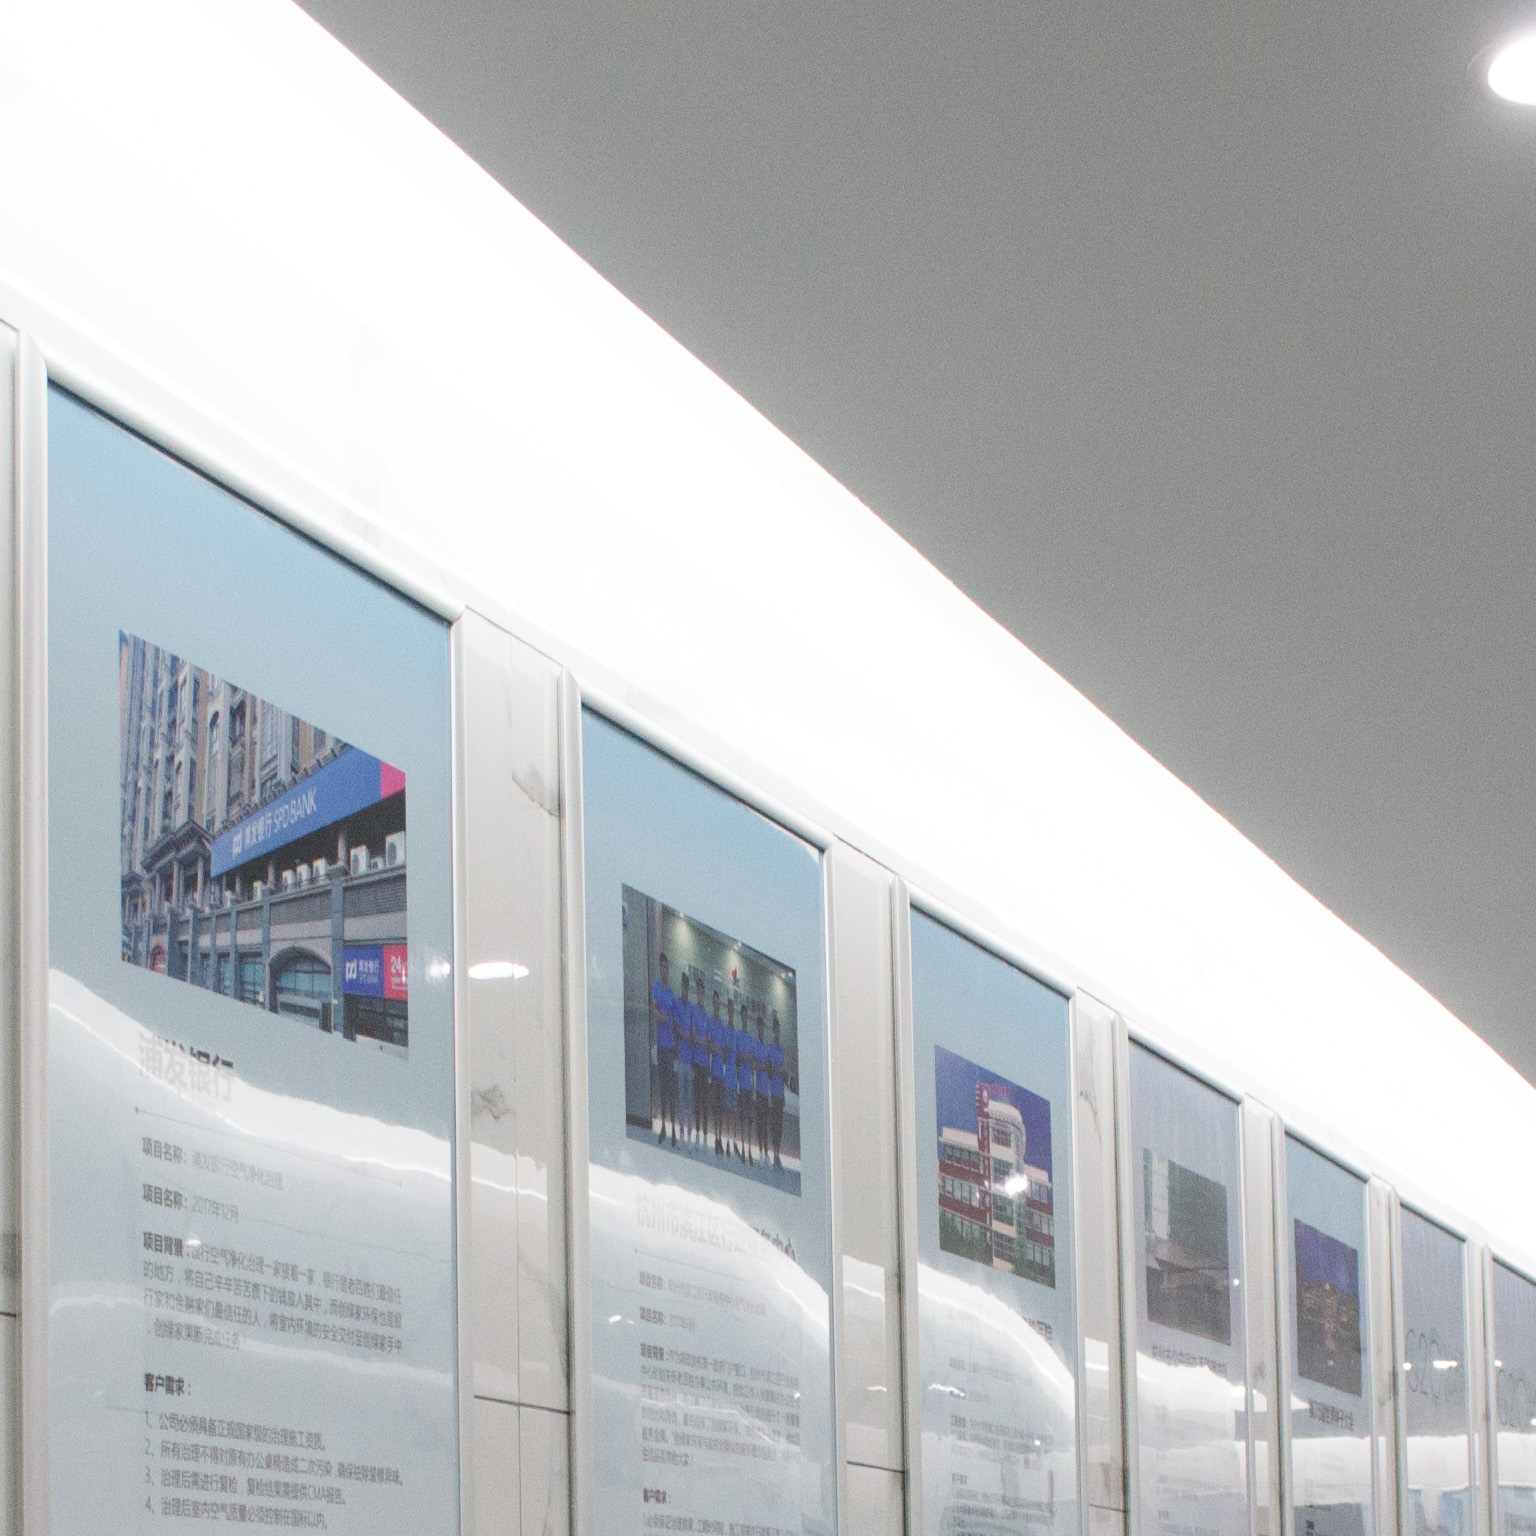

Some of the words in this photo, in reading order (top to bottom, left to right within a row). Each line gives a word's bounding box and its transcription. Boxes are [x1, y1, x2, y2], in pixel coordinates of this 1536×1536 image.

[290, 786, 317, 824] BANK
[139, 1030, 233, 1103] 浦发银行
